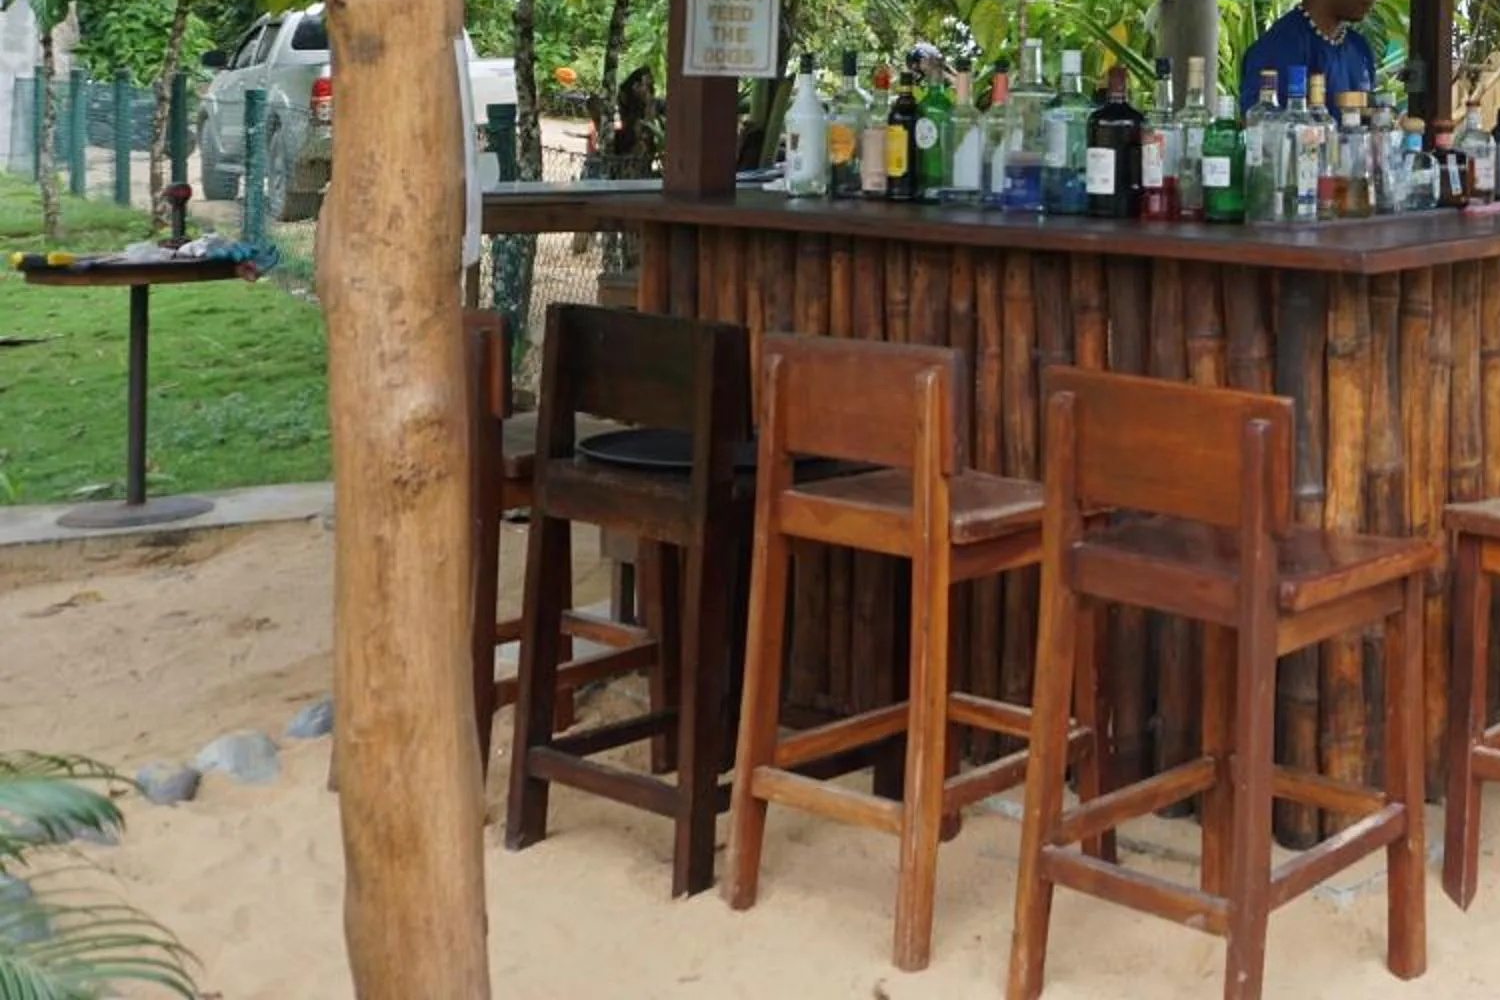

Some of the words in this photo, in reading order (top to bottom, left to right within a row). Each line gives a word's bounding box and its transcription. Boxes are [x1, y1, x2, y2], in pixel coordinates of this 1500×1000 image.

[707, 5, 753, 22] FEED
[709, 25, 748, 43] THE
[703, 47, 754, 65] DOGS
